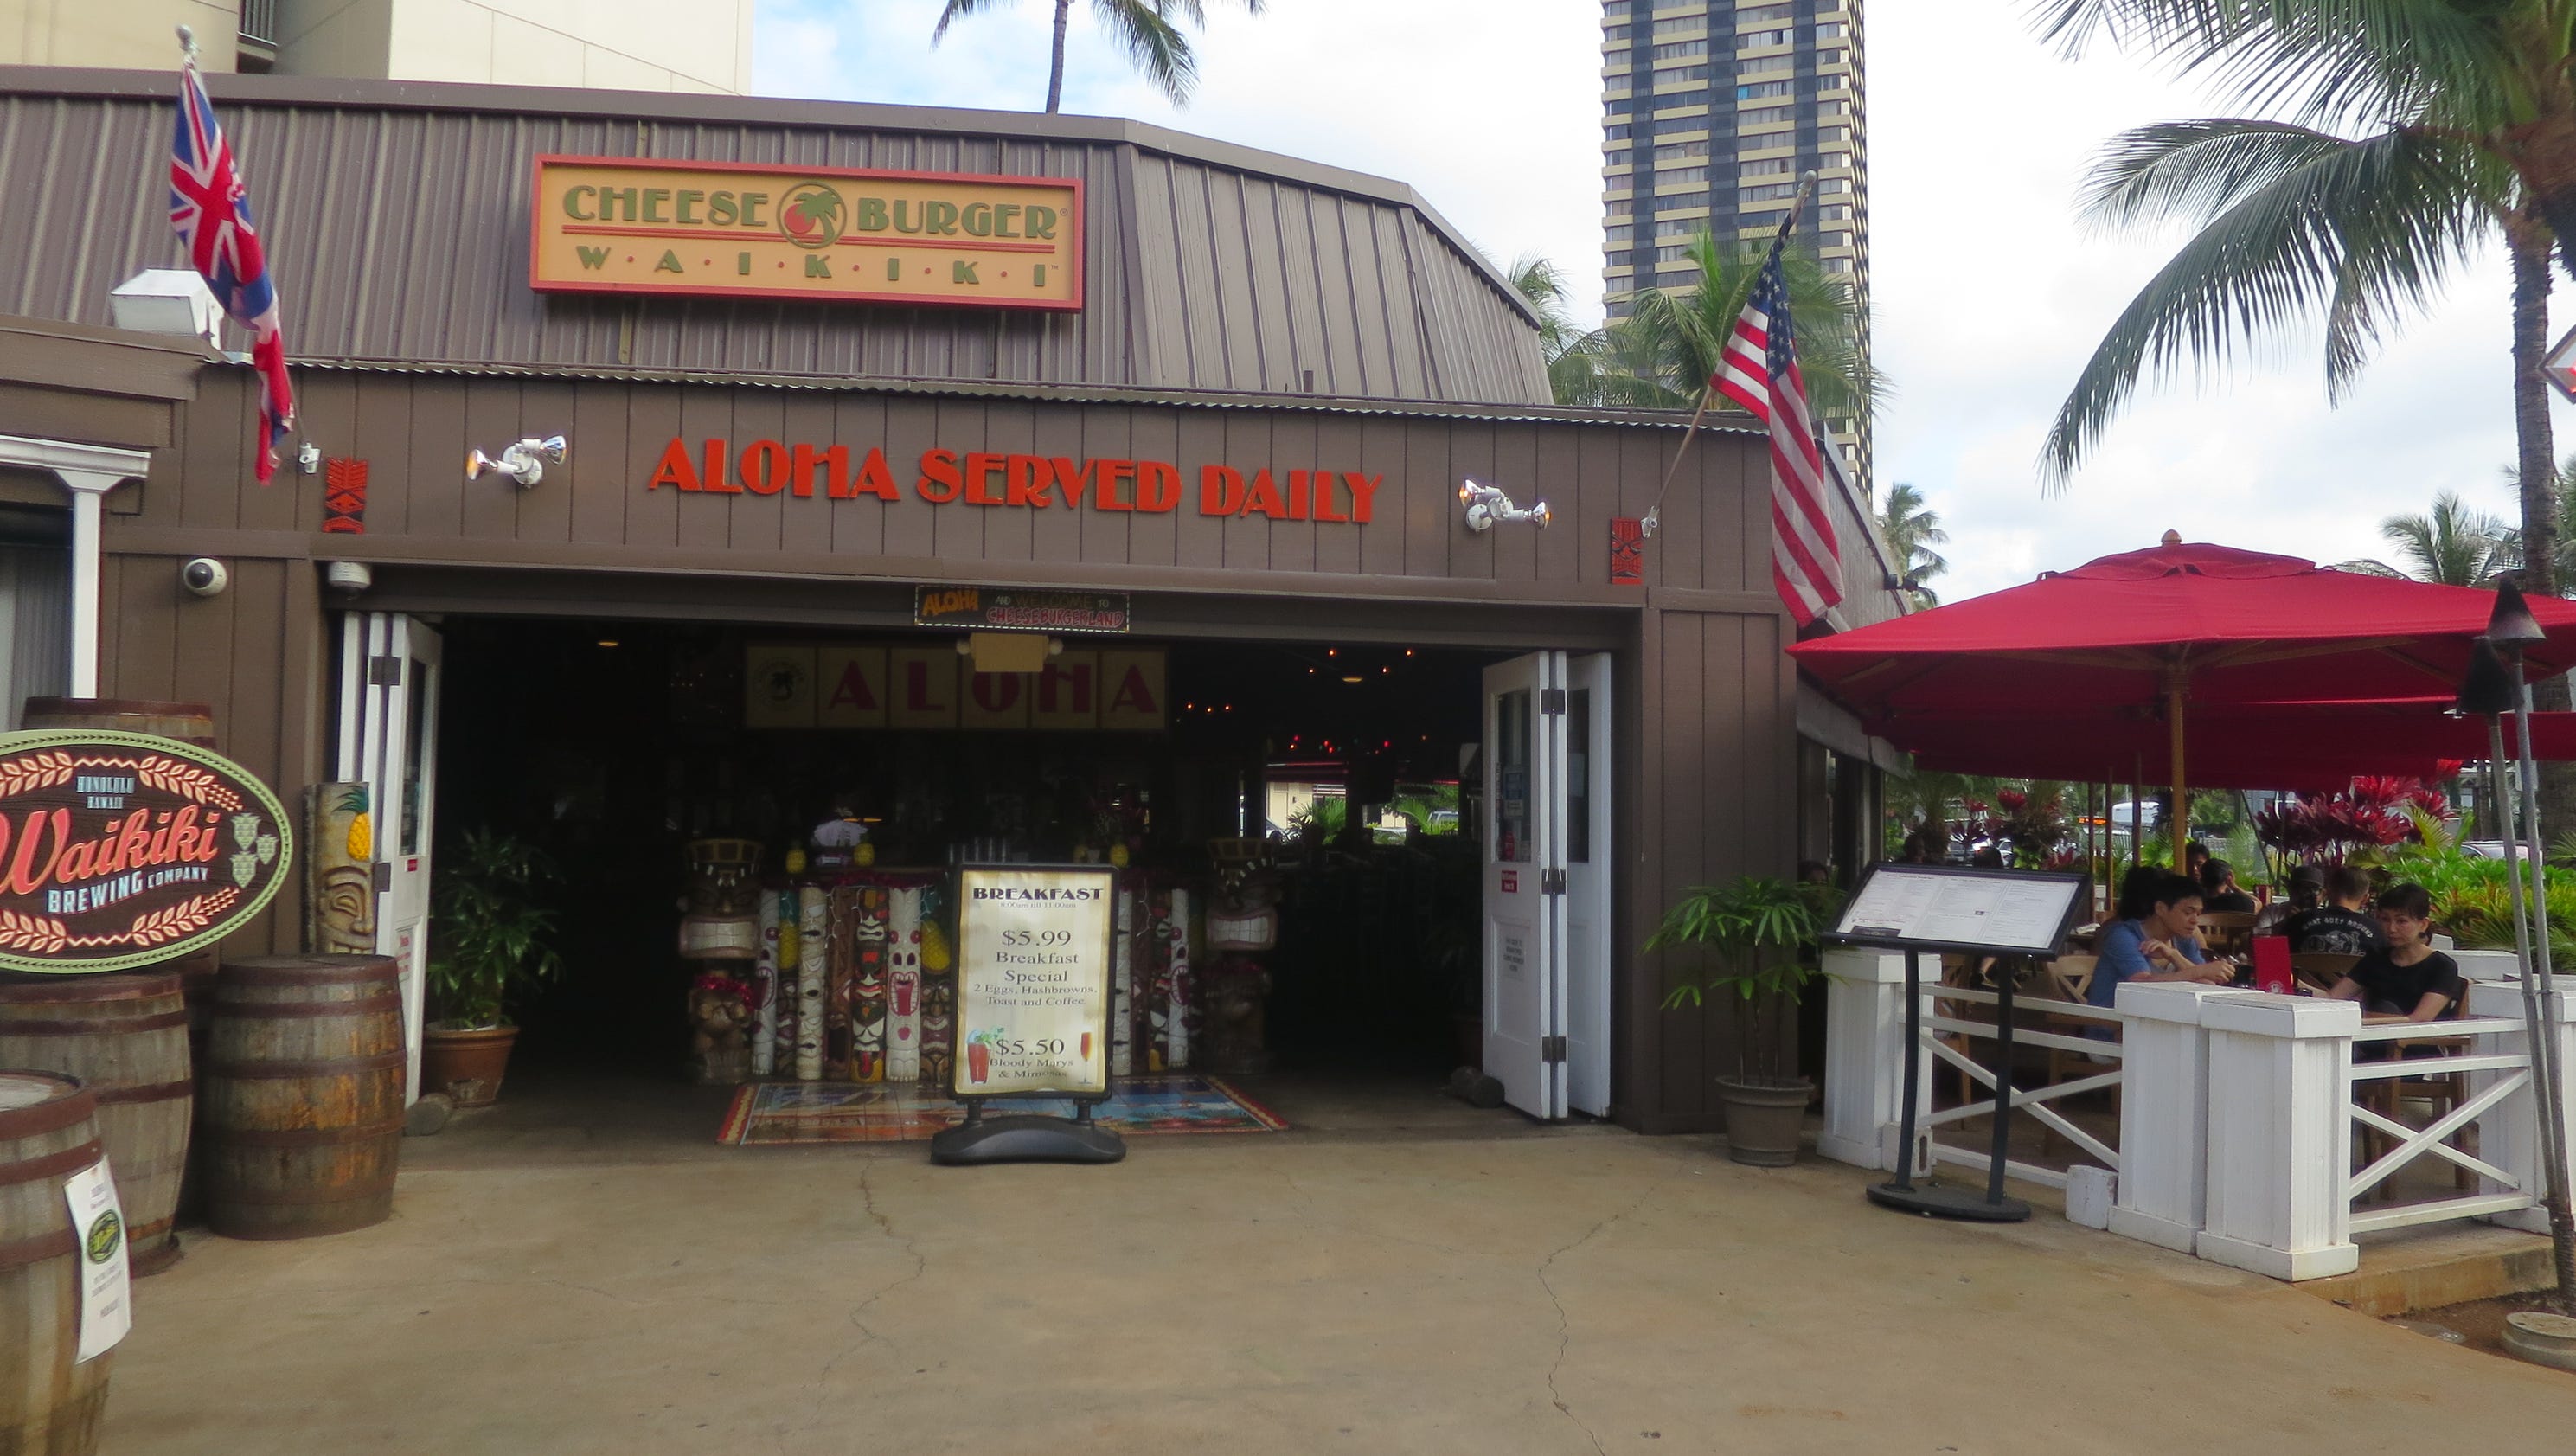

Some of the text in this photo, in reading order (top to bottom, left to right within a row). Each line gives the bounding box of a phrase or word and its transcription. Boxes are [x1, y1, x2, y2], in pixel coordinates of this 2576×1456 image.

[563, 184, 768, 227] CHEESE
[648, 437, 1383, 523] ALOHA SERVED DAILY
[921, 589, 1110, 616] ALOHA AND WELCOME TO
[986, 607, 1125, 628] CHEESEBURGERLAND
[827, 660, 1159, 715] ALOHA
[47, 867, 208, 914] BREWING COMPANY
[972, 888, 1105, 901] BREAKFAST
[1002, 929, 1072, 947] $5.99
[996, 951, 1080, 965] Breakfast
[1004, 969, 1068, 985] Special
[974, 984, 981, 992] 2
[986, 996, 1086, 1006] Toast and Coffee
[996, 1037, 1065, 1056] $5.50
[989, 1058, 1073, 1068] Bloody Marys
